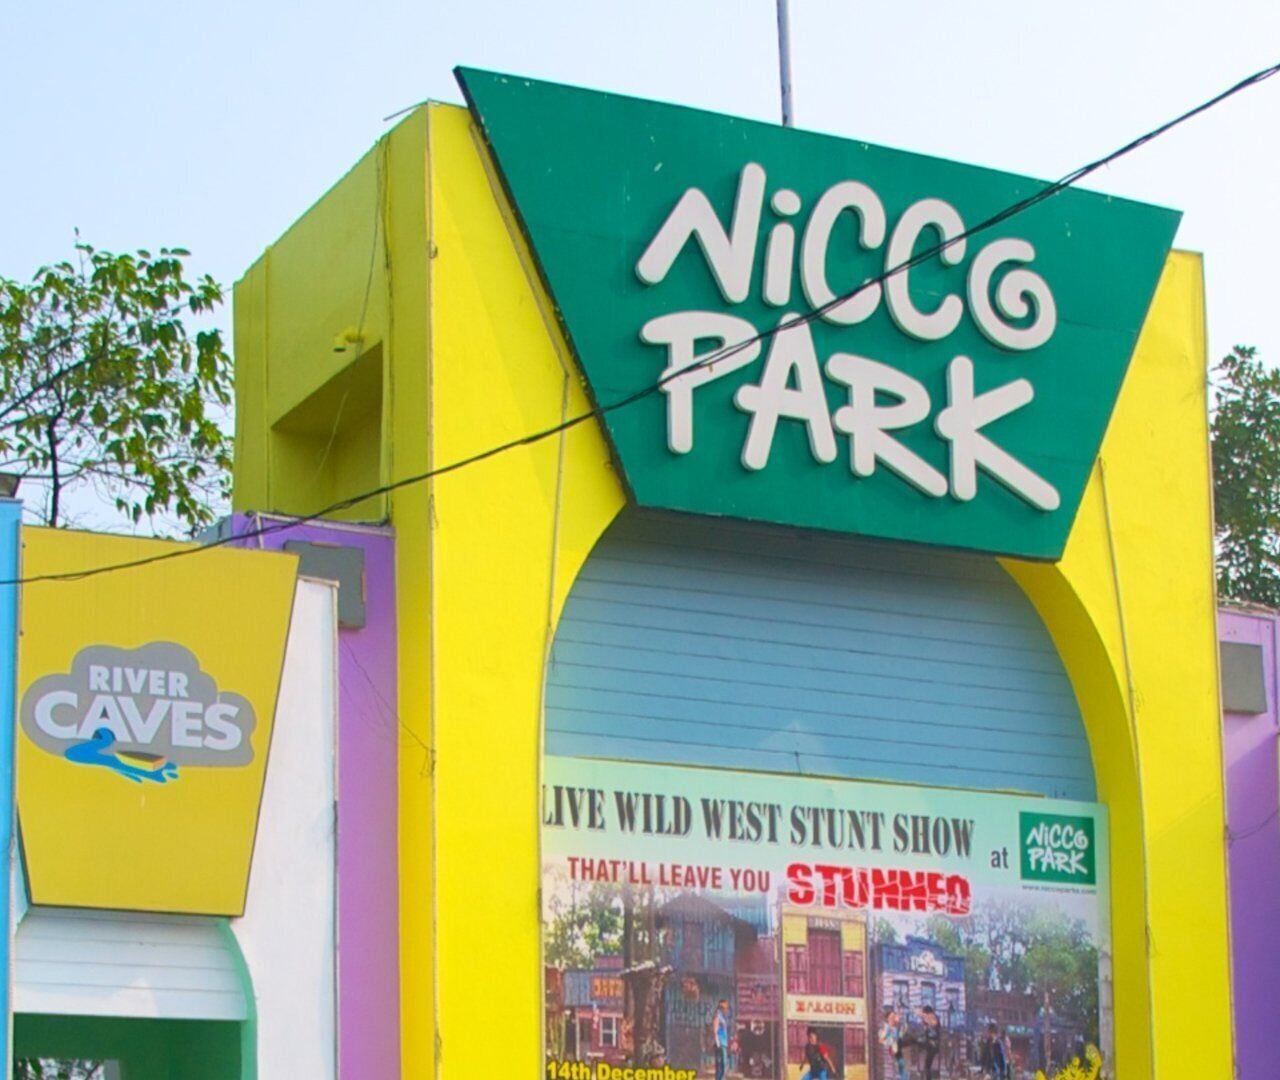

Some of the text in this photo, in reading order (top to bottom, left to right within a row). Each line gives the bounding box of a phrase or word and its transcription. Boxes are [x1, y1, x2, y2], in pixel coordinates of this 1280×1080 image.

[639, 311, 1061, 511] PARK
[89, 665, 189, 697] RIVER
[34, 690, 242, 751] CAVES
[543, 784, 1009, 869] LIVE WILD WEST STUNT SHOW at
[567, 857, 972, 916] THAT'LL LEAVE YOU STUNNED
[1027, 846, 1088, 875] PARK
[547, 1060, 593, 1080] 14th
